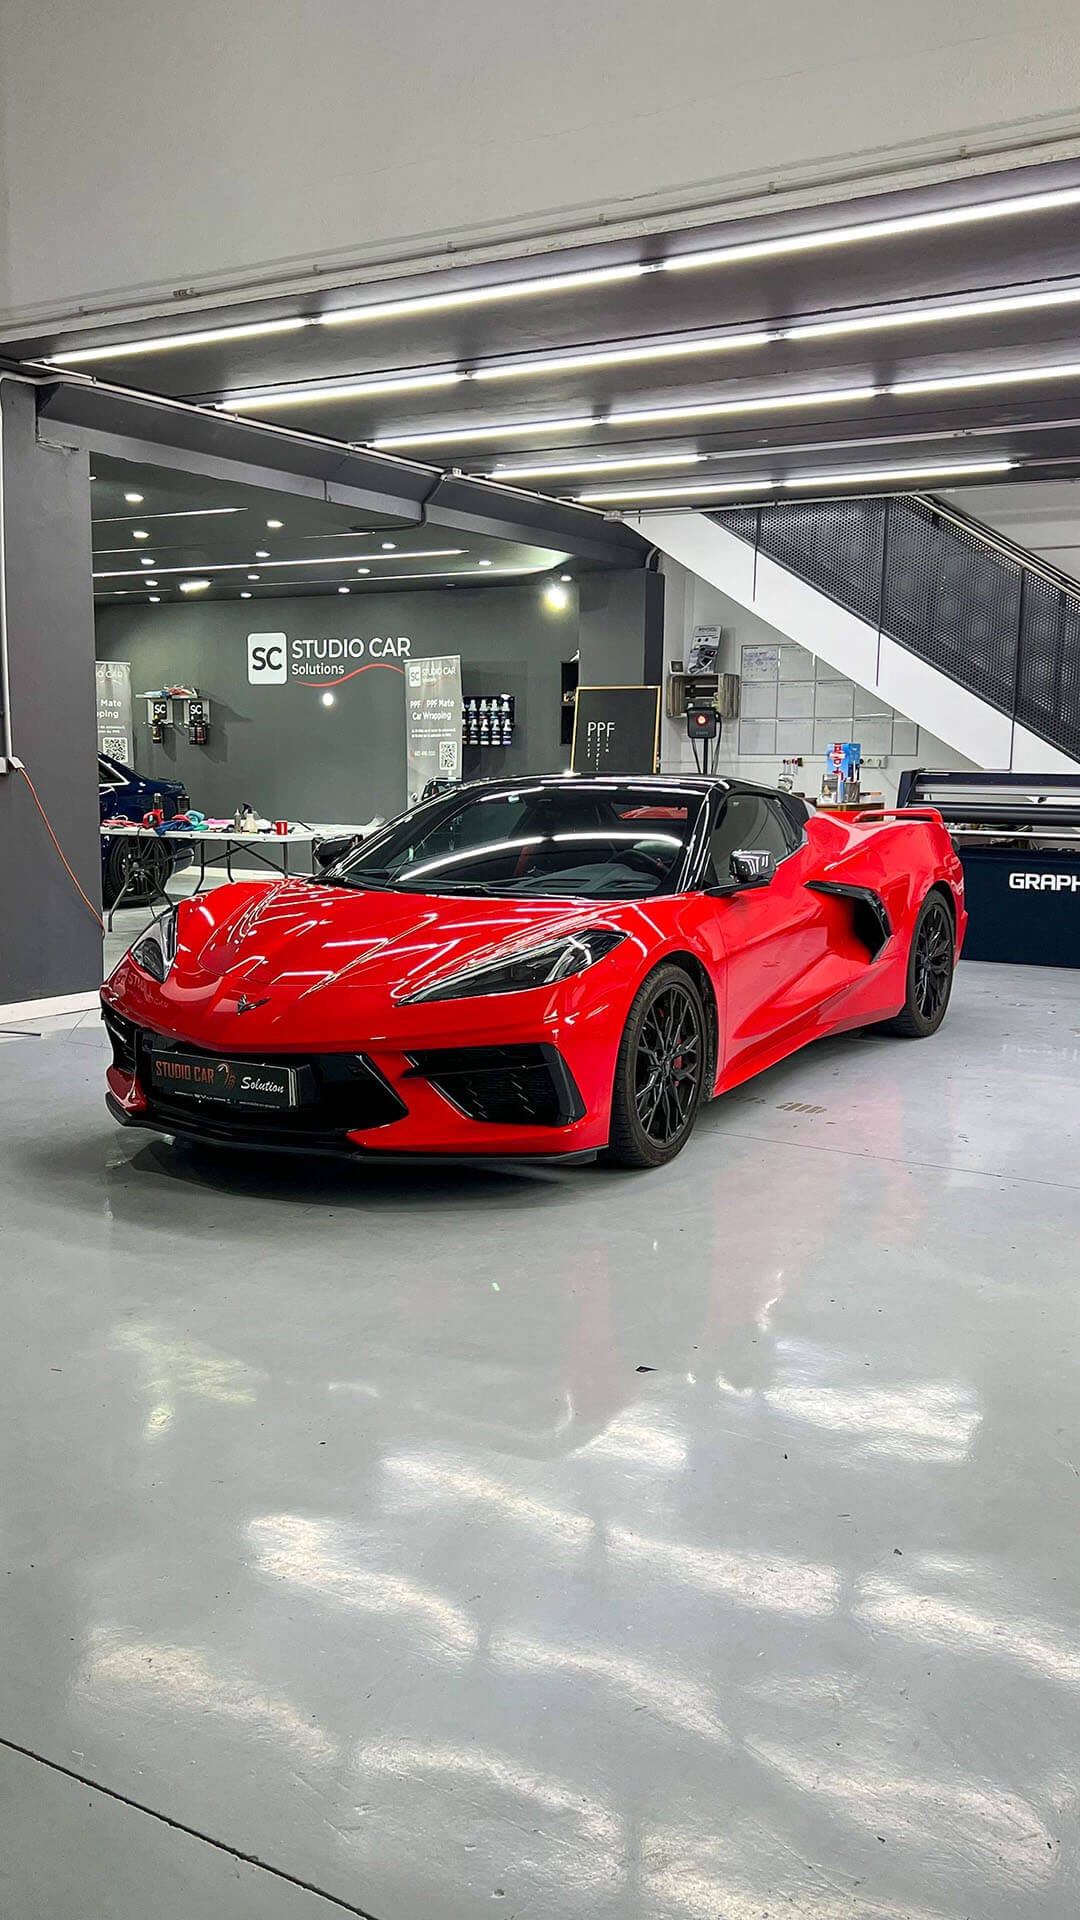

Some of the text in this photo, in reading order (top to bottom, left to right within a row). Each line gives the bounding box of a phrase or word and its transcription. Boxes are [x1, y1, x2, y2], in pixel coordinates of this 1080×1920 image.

[291, 637, 411, 659] STUDIO CAR
[252, 646, 283, 671] SC
[291, 662, 345, 676] Solutions
[442, 666, 456, 676] CAR
[410, 671, 420, 681] SC
[100, 699, 121, 708] Mate
[154, 703, 167, 714] SC
[410, 699, 455, 709] PPF PPF Mate
[190, 704, 202, 715] SC
[412, 711, 422, 721] Car
[587, 721, 616, 737] PPF
[155, 1060, 214, 1084] STUDIO CAR
[240, 1076, 285, 1094] Solution
